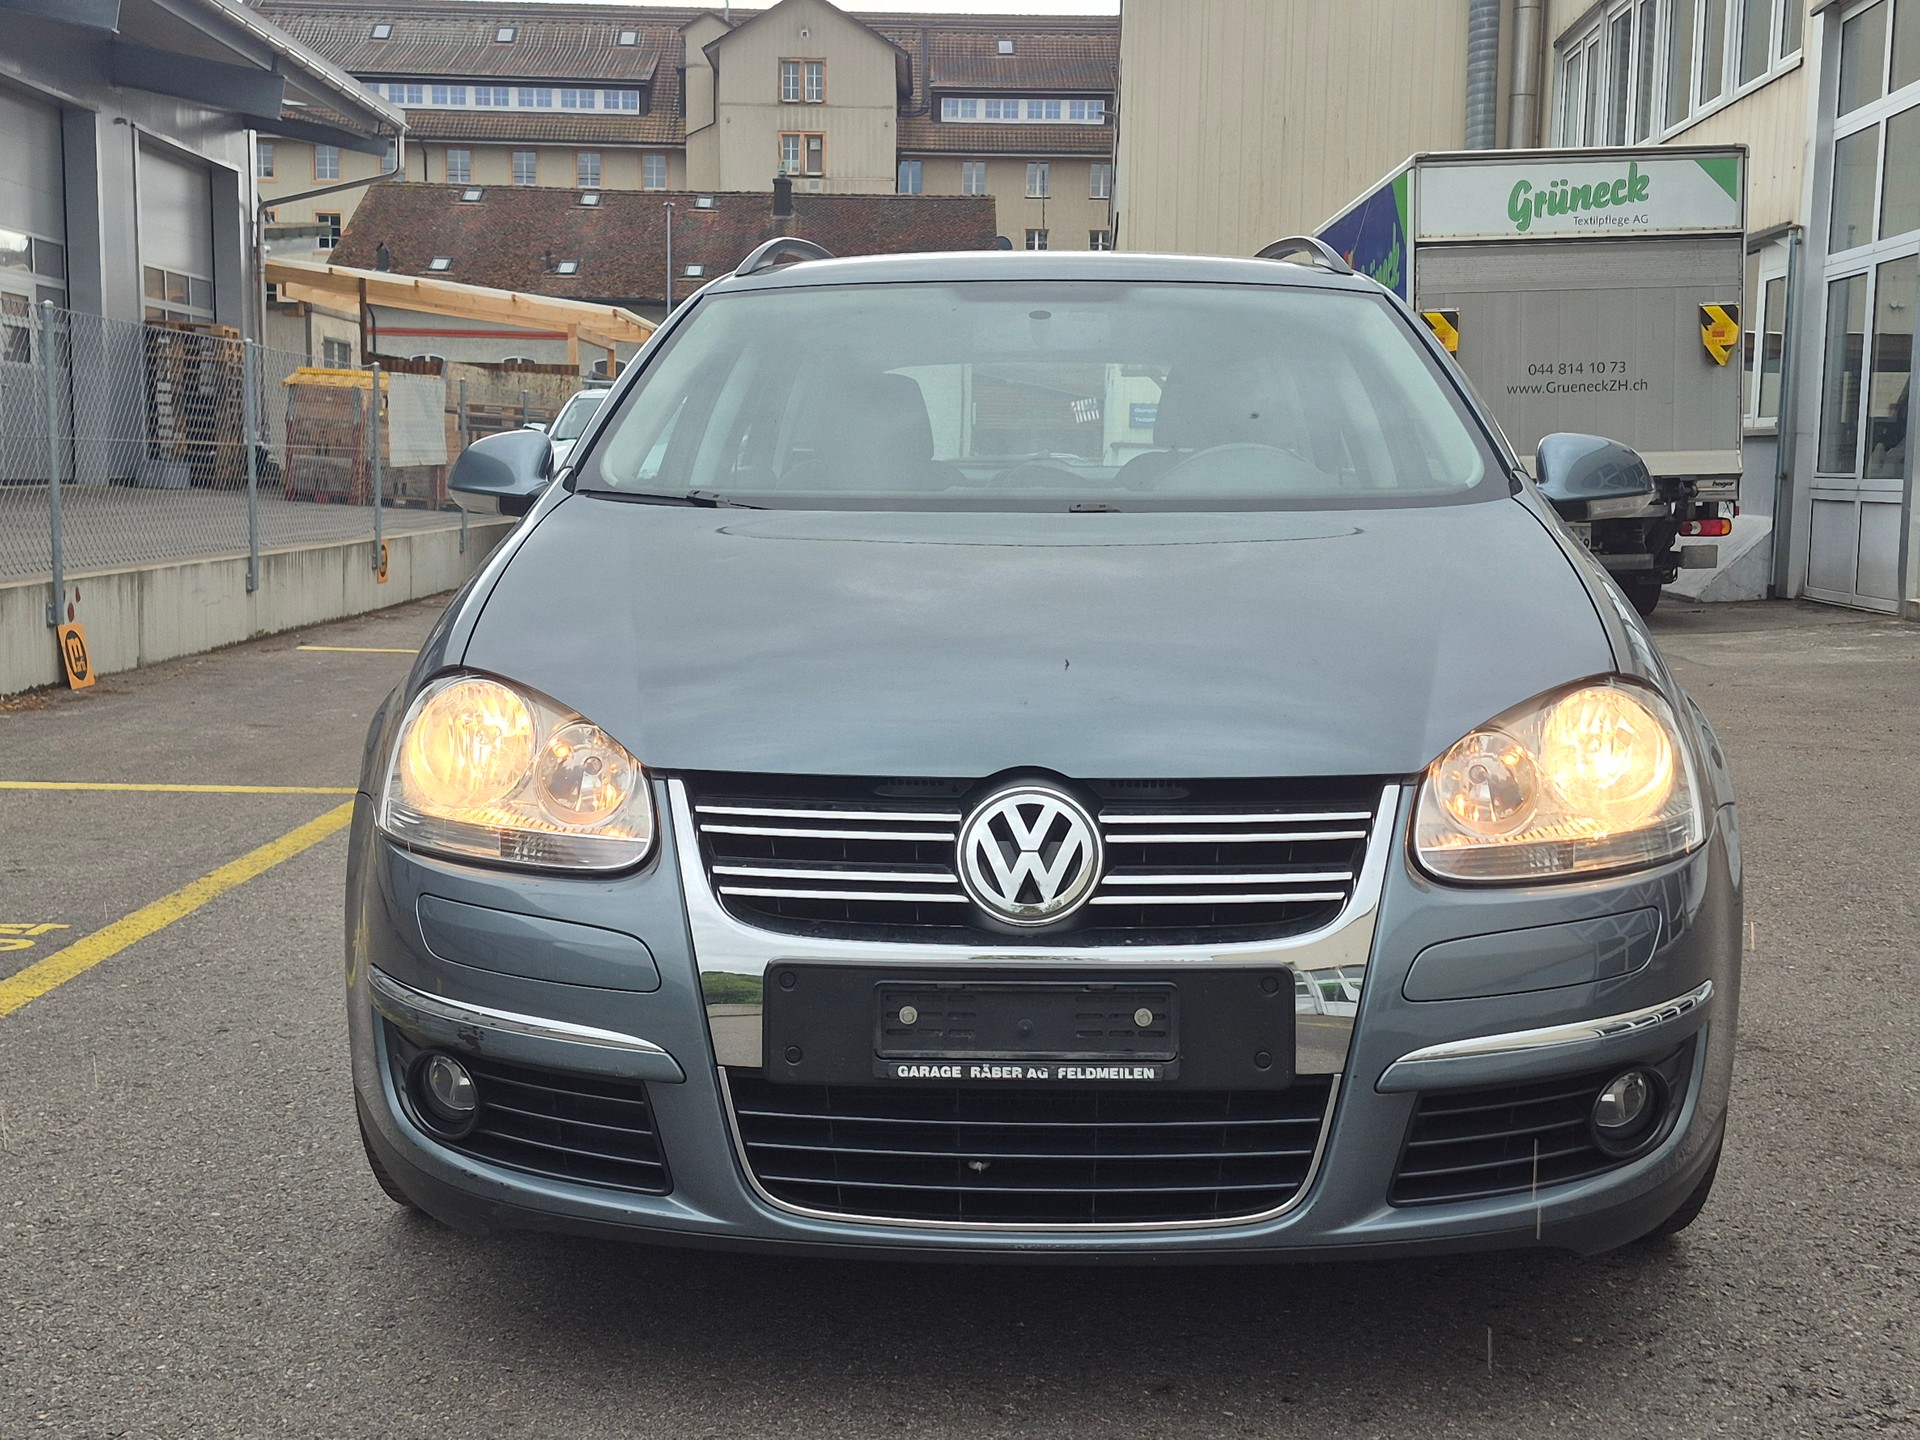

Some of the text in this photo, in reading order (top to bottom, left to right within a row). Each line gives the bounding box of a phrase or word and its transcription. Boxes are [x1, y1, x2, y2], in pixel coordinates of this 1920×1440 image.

[1508, 161, 1650, 232] Grüneck
[1573, 214, 1649, 227] Textilpflege AG
[1528, 361, 1626, 376] 044 814 10 73
[1506, 378, 1648, 394] www.GrueneckZH.ch
[897, 1065, 962, 1078] GARAGE
[970, 1063, 1023, 1079] RÄBER
[1057, 1066, 1155, 1079] FELDMEILEN
